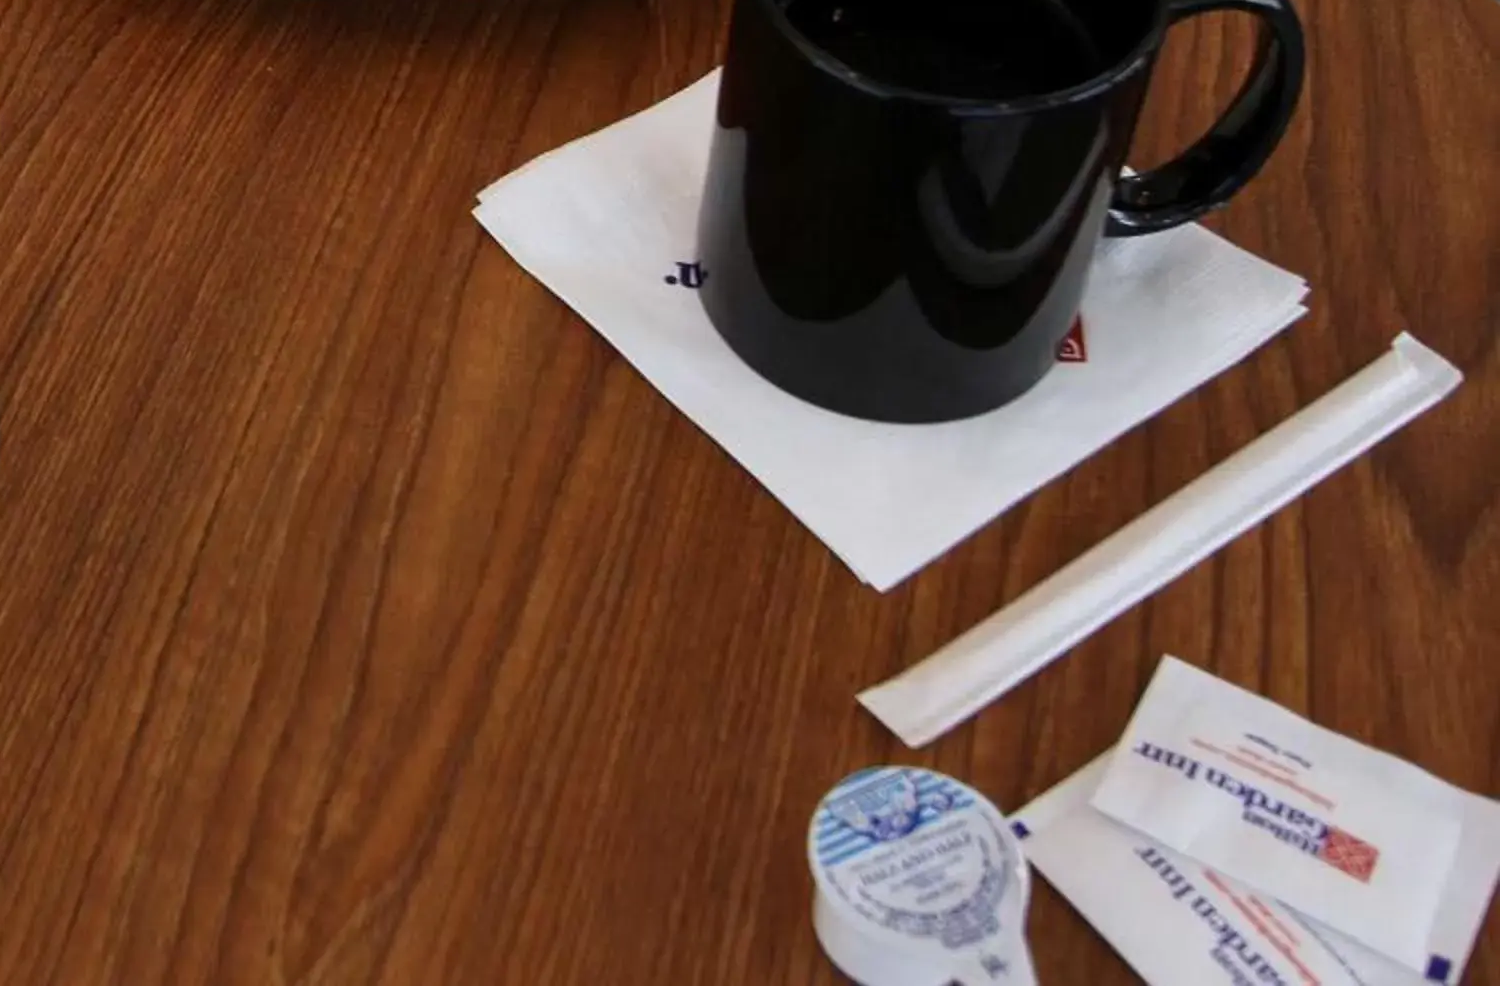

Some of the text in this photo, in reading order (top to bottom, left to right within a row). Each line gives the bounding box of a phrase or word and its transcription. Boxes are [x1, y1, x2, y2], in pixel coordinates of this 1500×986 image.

[1132, 741, 1202, 781] Inn
[1204, 768, 1331, 843] Garden
[1241, 811, 1321, 858] Hilton
[1133, 846, 1197, 900] Inn
